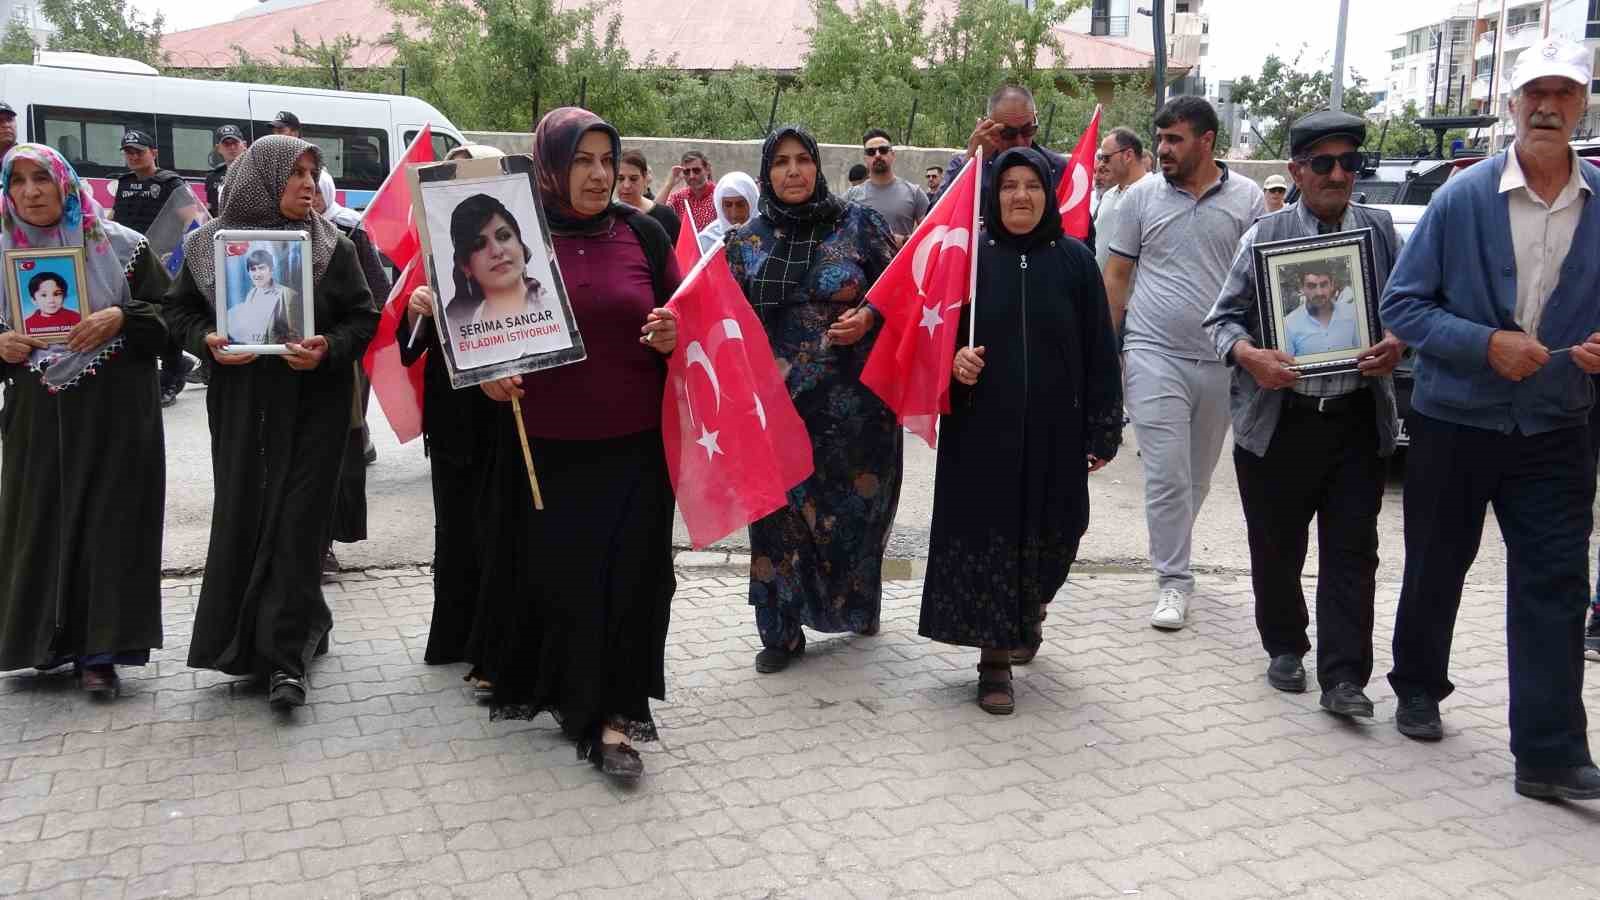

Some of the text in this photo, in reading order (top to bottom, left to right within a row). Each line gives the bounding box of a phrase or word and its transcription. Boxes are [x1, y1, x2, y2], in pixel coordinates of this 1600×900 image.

[459, 324, 560, 351] EVLADIMI İSTİYORUM!
[460, 310, 553, 339] ŞERİMA SANCAR
